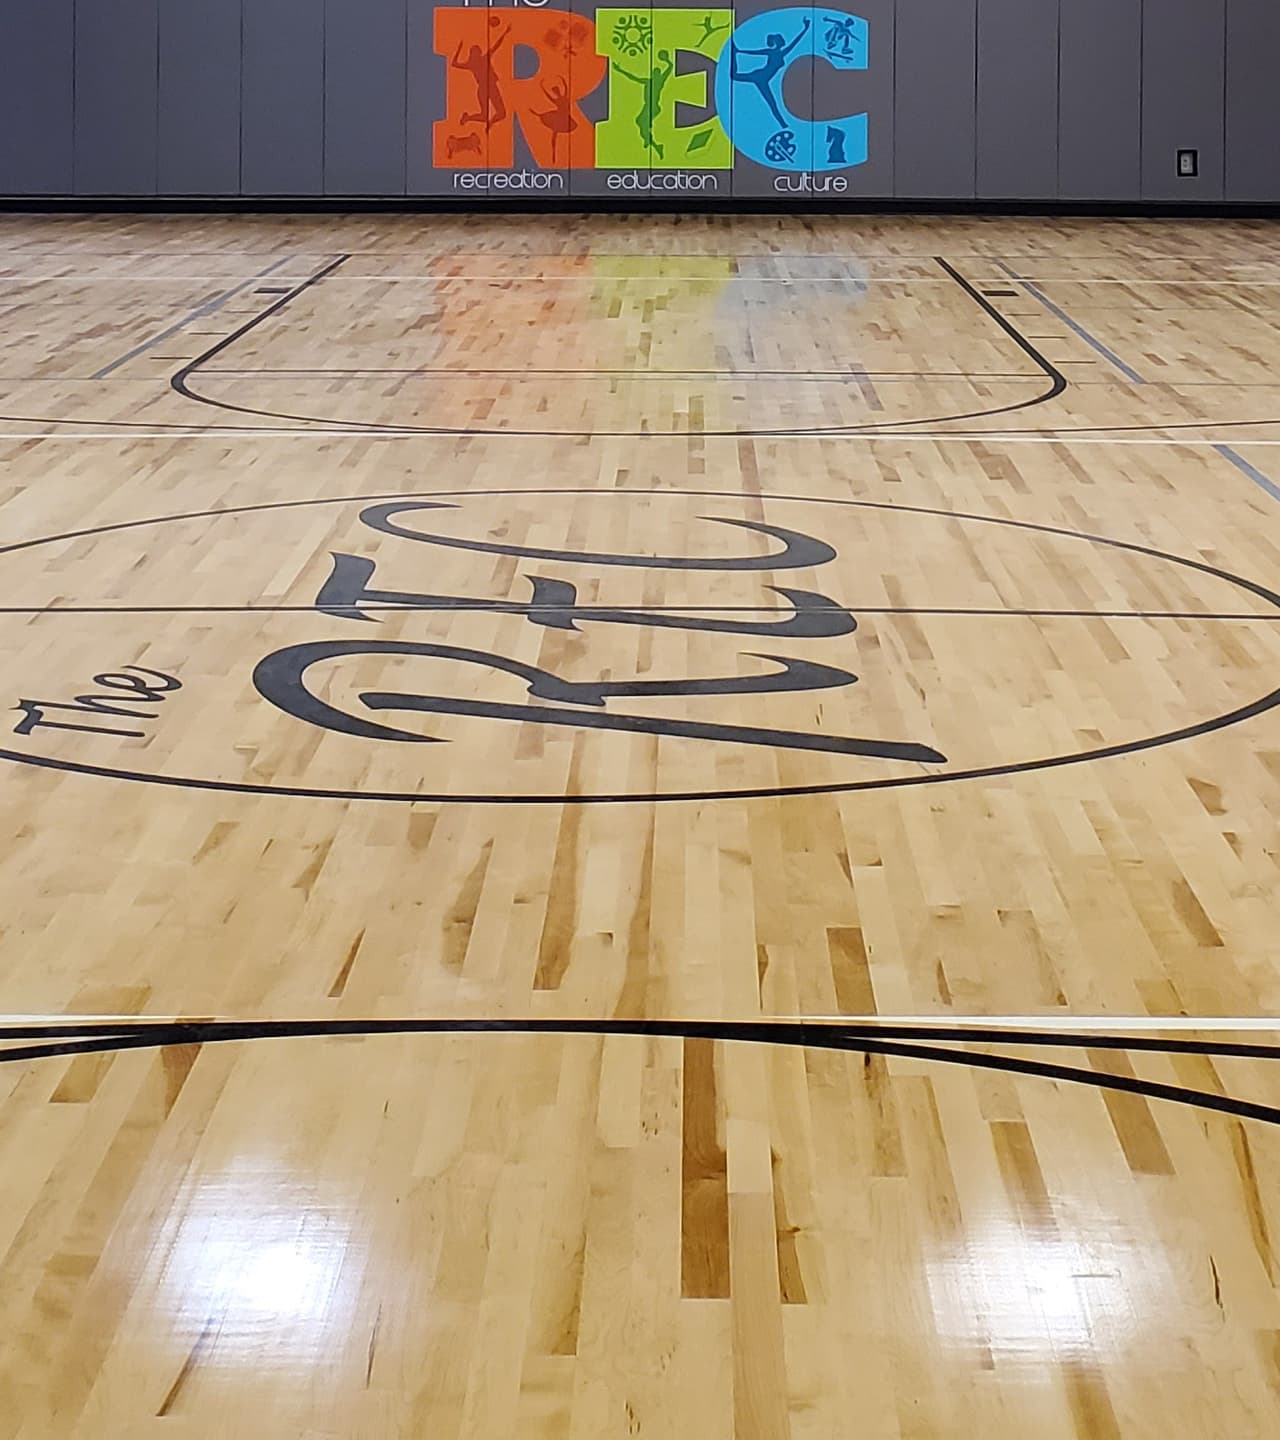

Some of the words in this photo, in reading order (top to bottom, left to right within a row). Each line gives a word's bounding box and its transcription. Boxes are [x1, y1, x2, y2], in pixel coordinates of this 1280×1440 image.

[432, 7, 869, 171] REC
[453, 168, 563, 190] recreation
[607, 168, 717, 191] education
[774, 170, 848, 192] culture
[252, 501, 948, 764] REC
[8, 665, 183, 738] The
